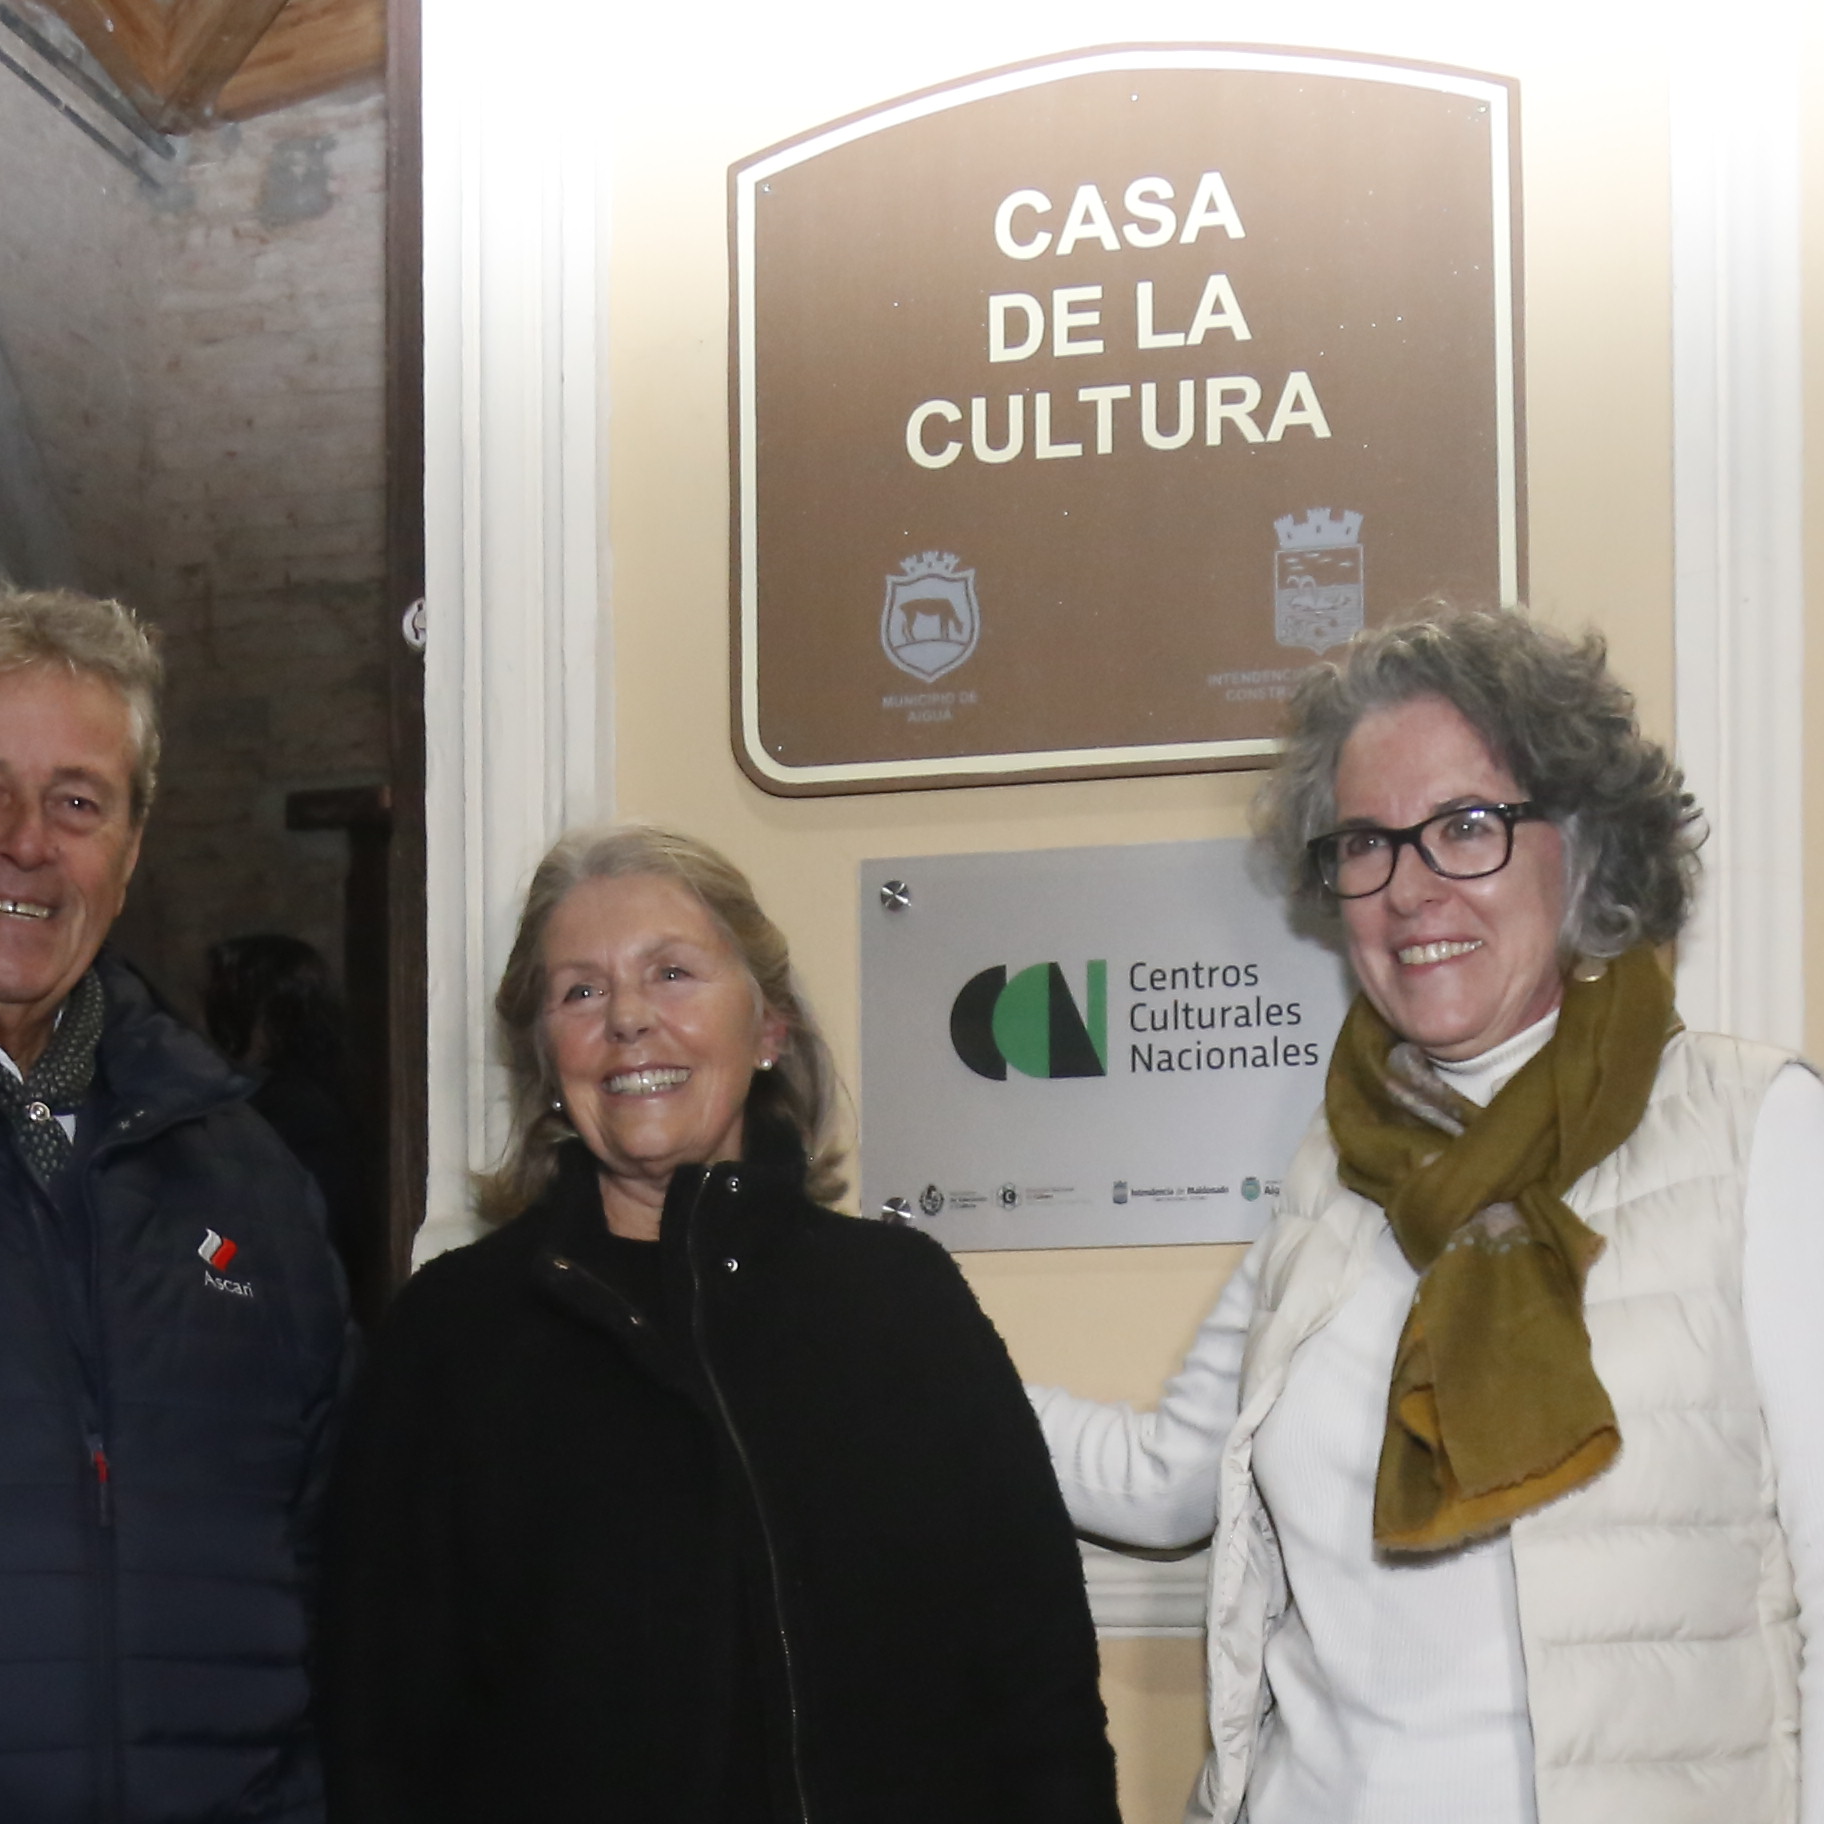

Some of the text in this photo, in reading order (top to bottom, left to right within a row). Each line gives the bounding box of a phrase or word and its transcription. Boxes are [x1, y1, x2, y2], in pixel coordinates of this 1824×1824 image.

[993, 171, 1246, 260] CASA
[987, 273, 1253, 363] DE LA
[905, 371, 1332, 469] CULTURA
[881, 691, 955, 708] MUNICIPIO
[1129, 960, 1259, 992] Centros
[1129, 996, 1302, 1032] Culturales
[1129, 1036, 1320, 1073] Nacionales
[204, 1270, 254, 1298] Ascari
